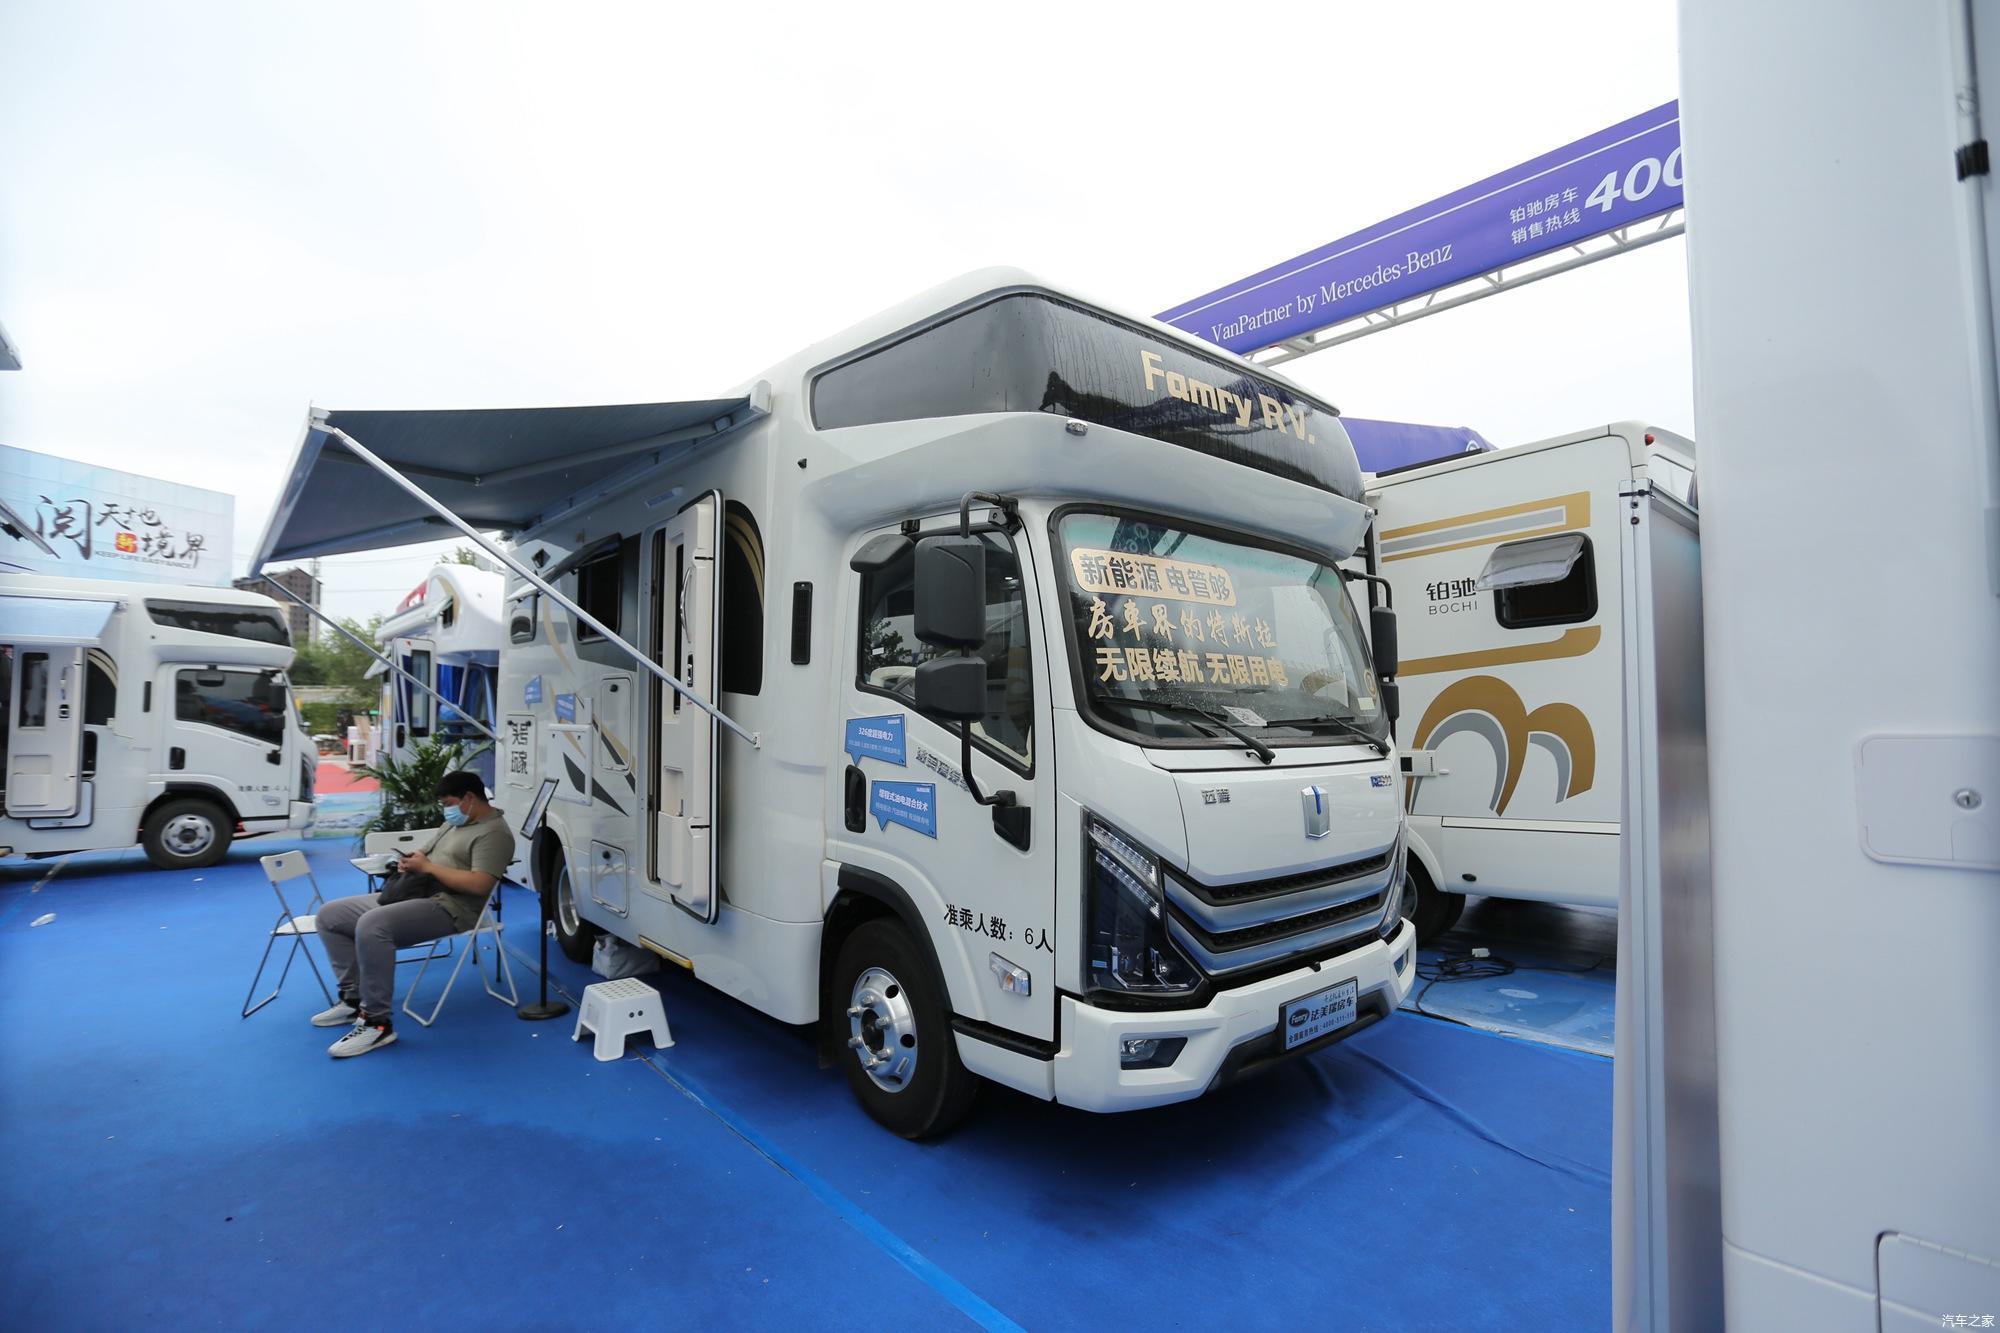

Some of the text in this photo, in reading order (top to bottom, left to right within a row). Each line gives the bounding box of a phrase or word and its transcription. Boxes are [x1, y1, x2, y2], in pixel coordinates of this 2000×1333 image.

[1509, 187, 1579, 224] 铂驰房车
[1511, 208, 1581, 245] 销售热线
[1211, 243, 1453, 343] VanPartner by Mercedes-Benz
[1141, 350, 1316, 445] Famry RV.
[35, 494, 92, 560] 阅
[95, 502, 162, 531] 天地
[1079, 553, 1231, 602] 新能源 电管够
[1428, 600, 1478, 615] BOCHI
[1096, 647, 1289, 687] 无限续航 无限用电
